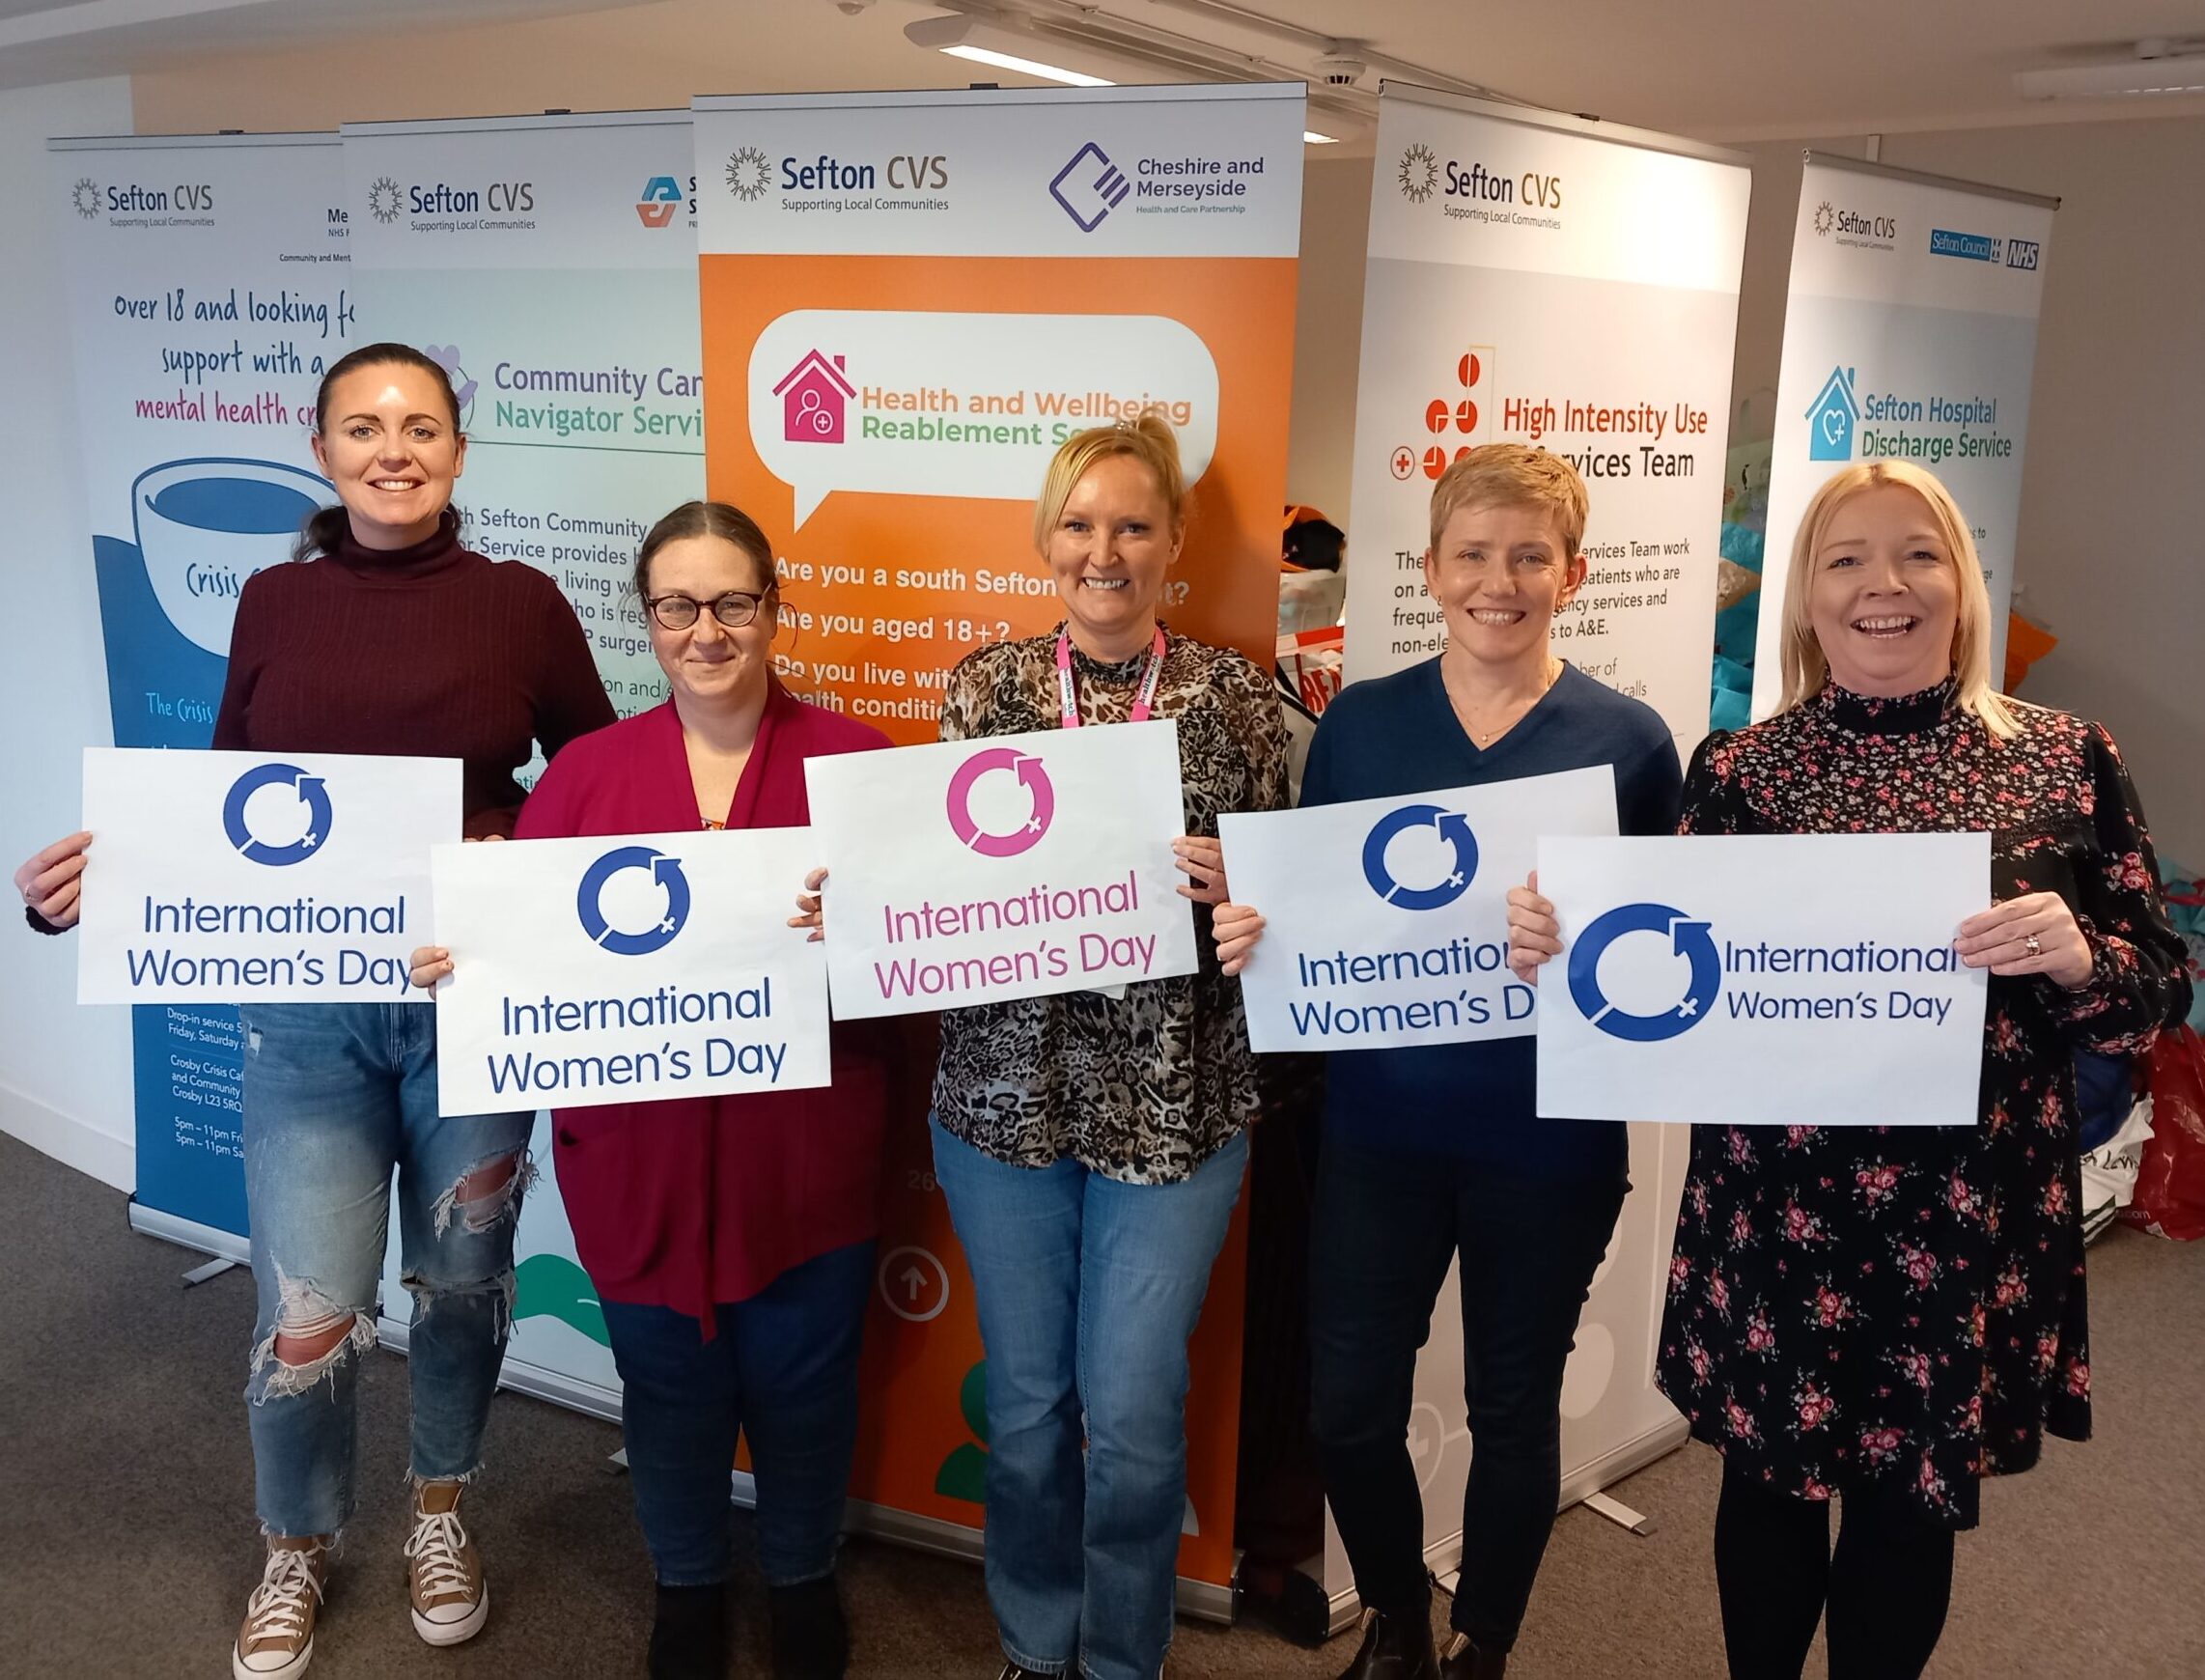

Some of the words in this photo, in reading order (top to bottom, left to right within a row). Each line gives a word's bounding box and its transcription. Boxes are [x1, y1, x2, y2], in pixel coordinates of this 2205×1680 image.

[782, 155, 875, 189] Sefton
[887, 156, 948, 189] CVS
[1137, 158, 1221, 176] Cheshire
[1227, 156, 1264, 174] and
[108, 185, 167, 210] Sefton
[174, 184, 212, 210] CVS
[410, 183, 479, 214] Sefton
[488, 182, 534, 212] CVS
[1137, 180, 1246, 201] Merseyside
[1444, 160, 1514, 204] Sefton
[1521, 173, 1561, 210] CVS
[782, 199, 842, 212] Supporting
[845, 198, 872, 210] Local
[875, 198, 949, 210] Communities
[1200, 206, 1245, 214] Partnership
[1443, 205, 1489, 224] Supporting
[1490, 210, 1511, 225] Local
[1512, 211, 1561, 230] Communities
[110, 218, 148, 228] Supporting
[150, 218, 167, 227] Local
[168, 217, 214, 227] Communities
[411, 221, 455, 234] Supporting
[457, 220, 478, 231] Local
[479, 218, 536, 231] Communities
[1836, 210, 1871, 237] Sefton
[1874, 217, 1895, 239] CVS
[280, 254, 317, 263] Community
[1932, 232, 1960, 252] Sefton
[1960, 238, 1990, 257] Council
[2008, 241, 2038, 267] NHS
[167, 289, 184, 322] 18
[194, 289, 237, 321] and
[249, 291, 327, 338] looking
[162, 340, 242, 384] support
[253, 341, 301, 374] with
[311, 353, 324, 375] a
[494, 362, 647, 402] Community
[135, 388, 206, 422] mental
[215, 391, 288, 425] health
[862, 386, 959, 413] Health
[968, 391, 1024, 415] and
[1864, 393, 1922, 422] Sefton
[1929, 396, 1996, 430] Hospital
[496, 401, 624, 437] Navigator
[633, 406, 703, 437] Servi
[862, 415, 1043, 445] Reablement
[1504, 398, 1555, 439] High
[1564, 400, 1667, 440] Intensity
[1674, 402, 1708, 434] Use
[1862, 429, 1954, 463] Discharge
[1958, 431, 2012, 458] Service
[1640, 446, 1694, 477] Team
[481, 508, 540, 530] Sefton
[546, 513, 648, 543] Community
[480, 536, 545, 558] Service
[552, 545, 627, 565] provides
[1582, 543, 1626, 559] ervices
[1630, 541, 1661, 558] Team
[1663, 538, 1689, 556] work
[186, 563, 239, 598] Crisis
[565, 570, 611, 598] living
[775, 556, 813, 581] Are
[821, 565, 865, 588] you
[873, 568, 887, 581] a
[896, 568, 965, 592] south
[975, 569, 1057, 597] Sefton
[1635, 565, 1660, 582] who
[1663, 567, 1680, 580] are
[1394, 585, 1414, 598] on
[1593, 592, 1643, 610] services
[1646, 588, 1667, 605] and
[601, 602, 614, 621] is
[776, 605, 813, 630] Are
[821, 614, 864, 637] you
[872, 617, 935, 643] aged
[944, 619, 1011, 644] 18+?
[1559, 623, 1573, 639] to
[1576, 619, 1608, 638] A&E.
[774, 654, 805, 678] Do
[812, 661, 855, 685] you
[864, 661, 907, 686] live
[914, 666, 953, 689] wit
[1605, 658, 1618, 676] of
[628, 679, 661, 699] and
[146, 692, 172, 715] The
[178, 698, 213, 724] Crisis
[144, 894, 405, 935] International
[884, 870, 1139, 944] International
[127, 948, 324, 987] Women's
[339, 949, 412, 995] Day
[874, 939, 1068, 999] Women's
[1079, 933, 1157, 975] Day
[1298, 937, 1509, 988] Internatio
[1725, 940, 1958, 974] International
[167, 1007, 200, 1024] Drop-in
[202, 1017, 234, 1031] service
[503, 976, 771, 1037] International
[1289, 989, 1491, 1036] Women's
[1727, 991, 1878, 1021] Women's
[1888, 991, 1953, 1026] Day
[168, 1022, 197, 1042] Friday,
[199, 1029, 238, 1050] Saturday
[170, 1054, 201, 1074] Crosby
[203, 1062, 227, 1078] Crisis
[487, 1041, 691, 1094] Women's
[706, 1038, 787, 1084] Day
[172, 1072, 187, 1083] and
[189, 1076, 240, 1099] Community
[173, 1085, 203, 1105] Crosby
[205, 1093, 220, 1107] L23
[175, 1116, 193, 1132] 5pm
[204, 1125, 229, 1141] 11pm
[176, 1132, 195, 1147] 5pm
[206, 1139, 231, 1157] 11pm
[907, 1169, 935, 1192] 26
